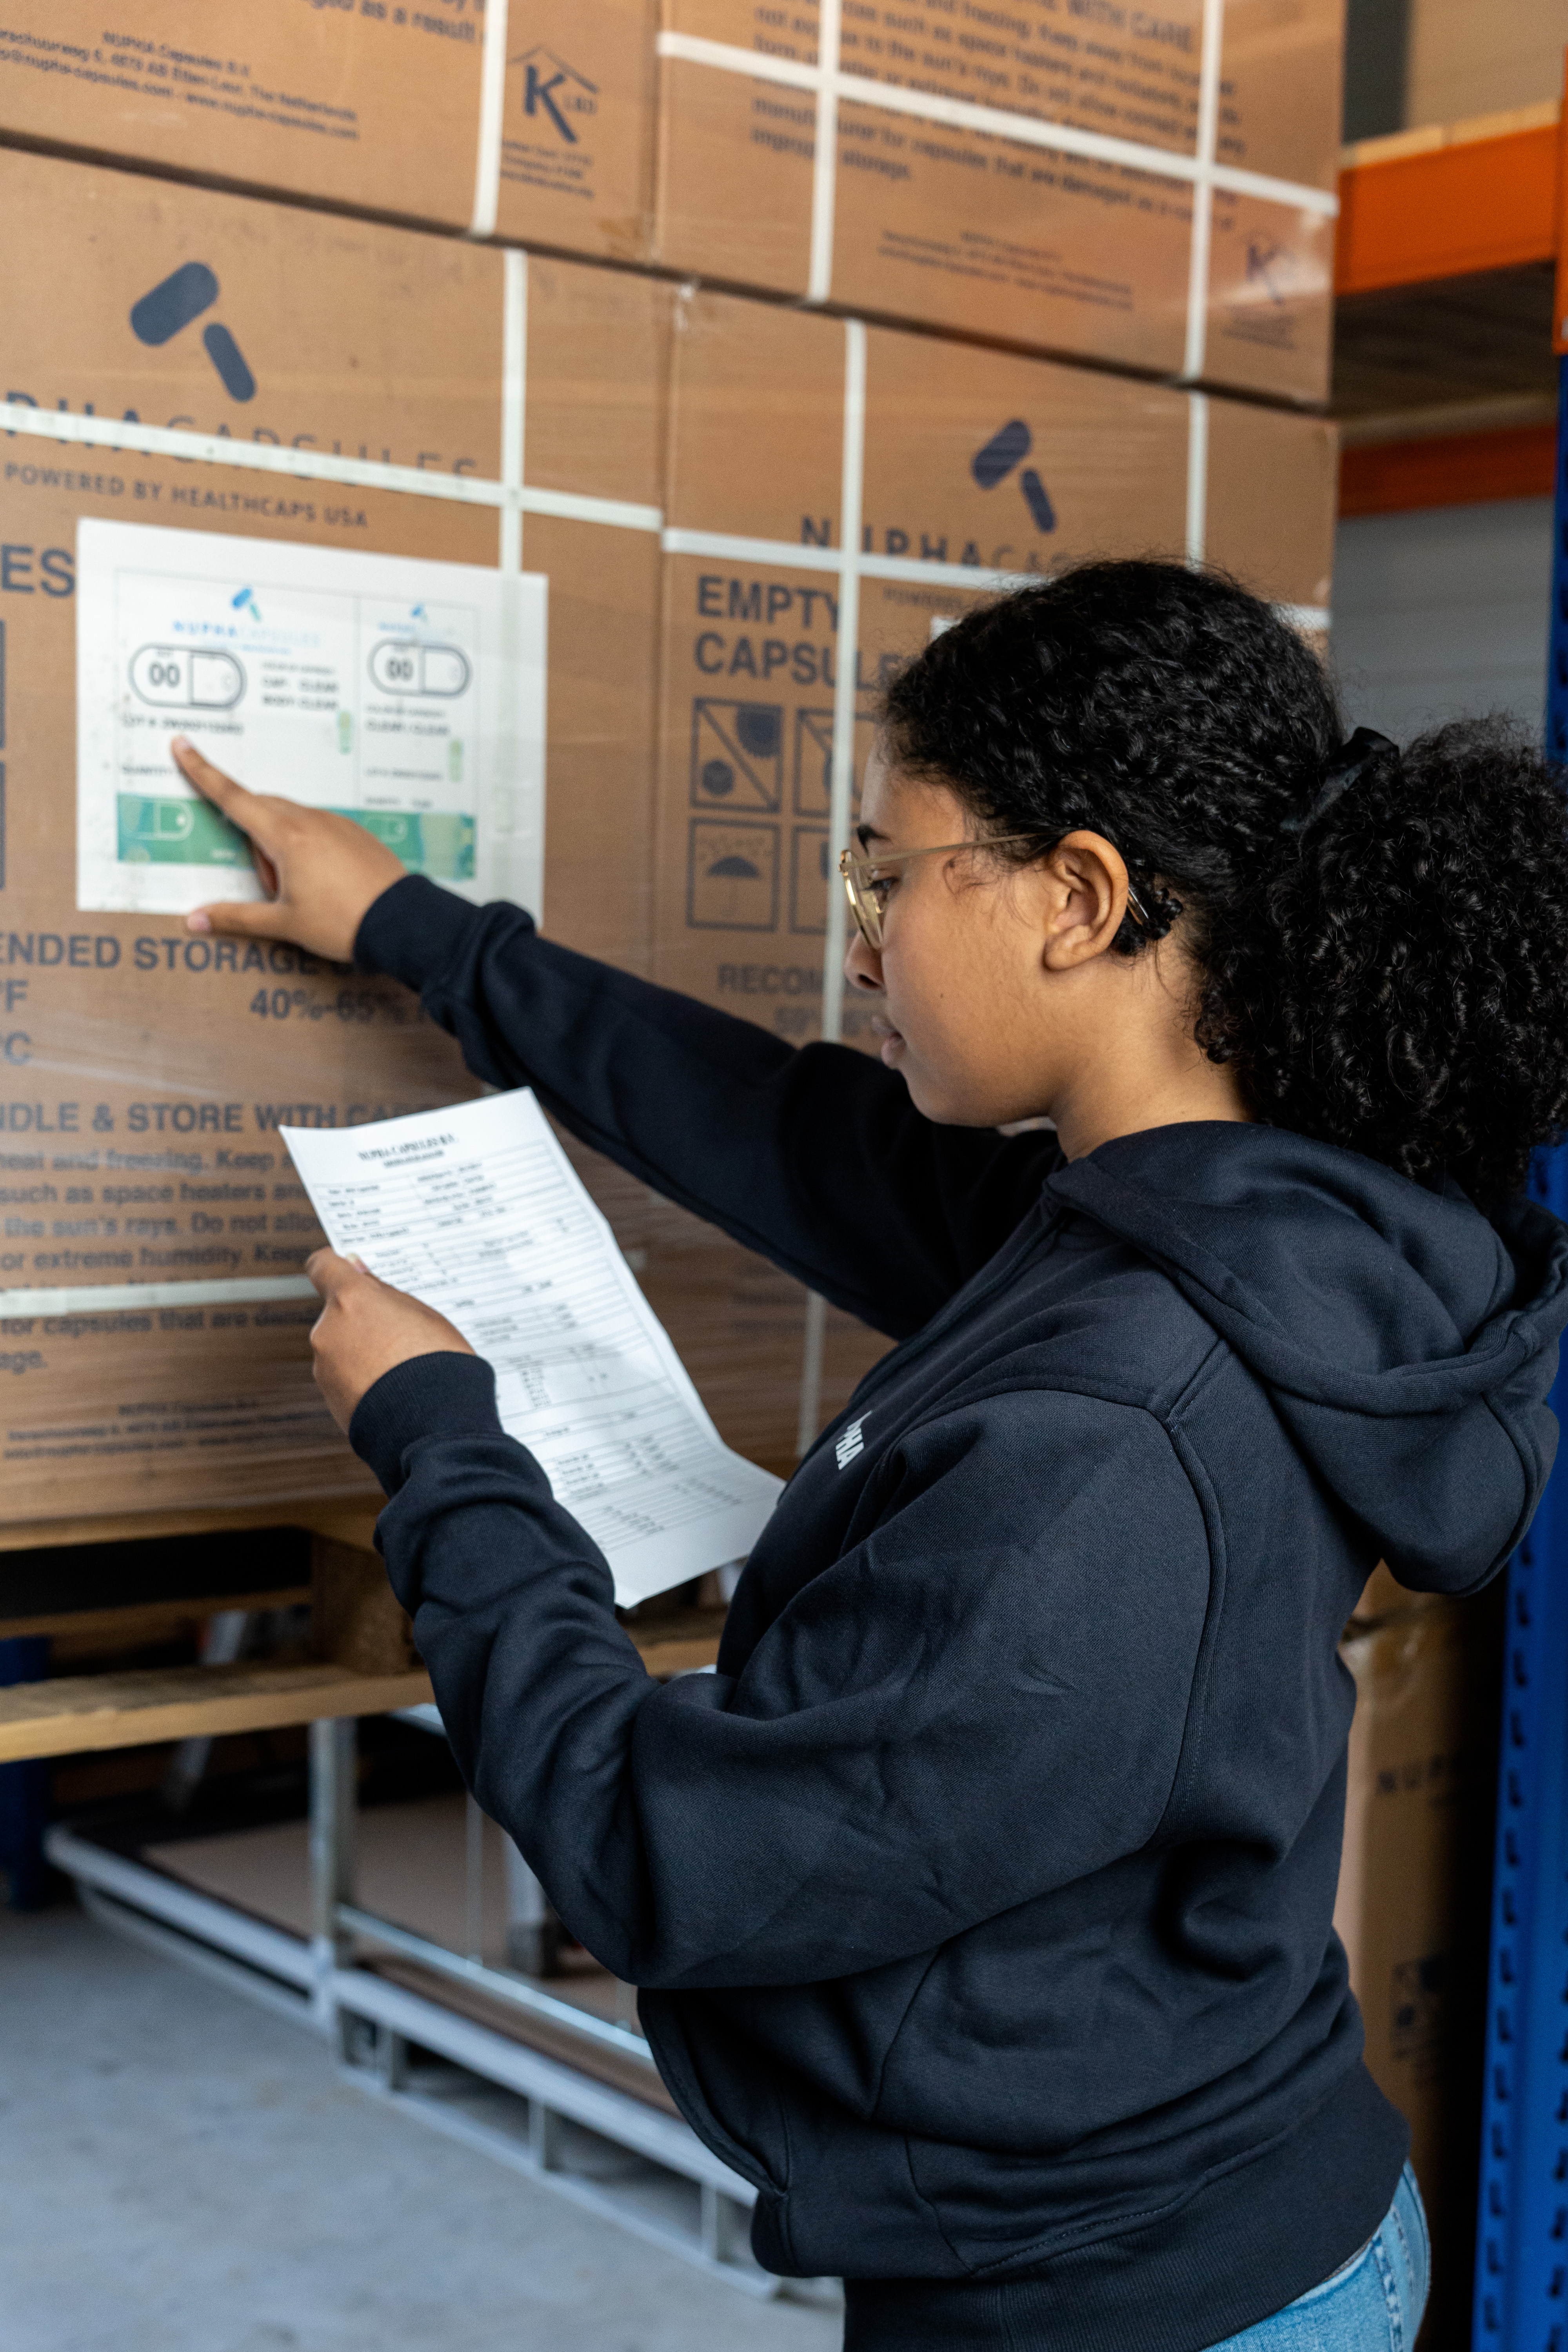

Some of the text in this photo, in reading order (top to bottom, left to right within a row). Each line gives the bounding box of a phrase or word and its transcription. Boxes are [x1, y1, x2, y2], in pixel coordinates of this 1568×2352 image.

[3, 461, 369, 529] POWERED BY HEALTHCAPS USA
[697, 574, 840, 632] EMPTY
[147, 661, 182, 690] 00
[385, 657, 415, 682] 00
[694, 631, 902, 692] CAPSULE
[0, 930, 122, 969] NDED
[0, 1102, 80, 1132] DLE
[92, 1102, 114, 1132] &
[127, 1102, 245, 1133] STORE
